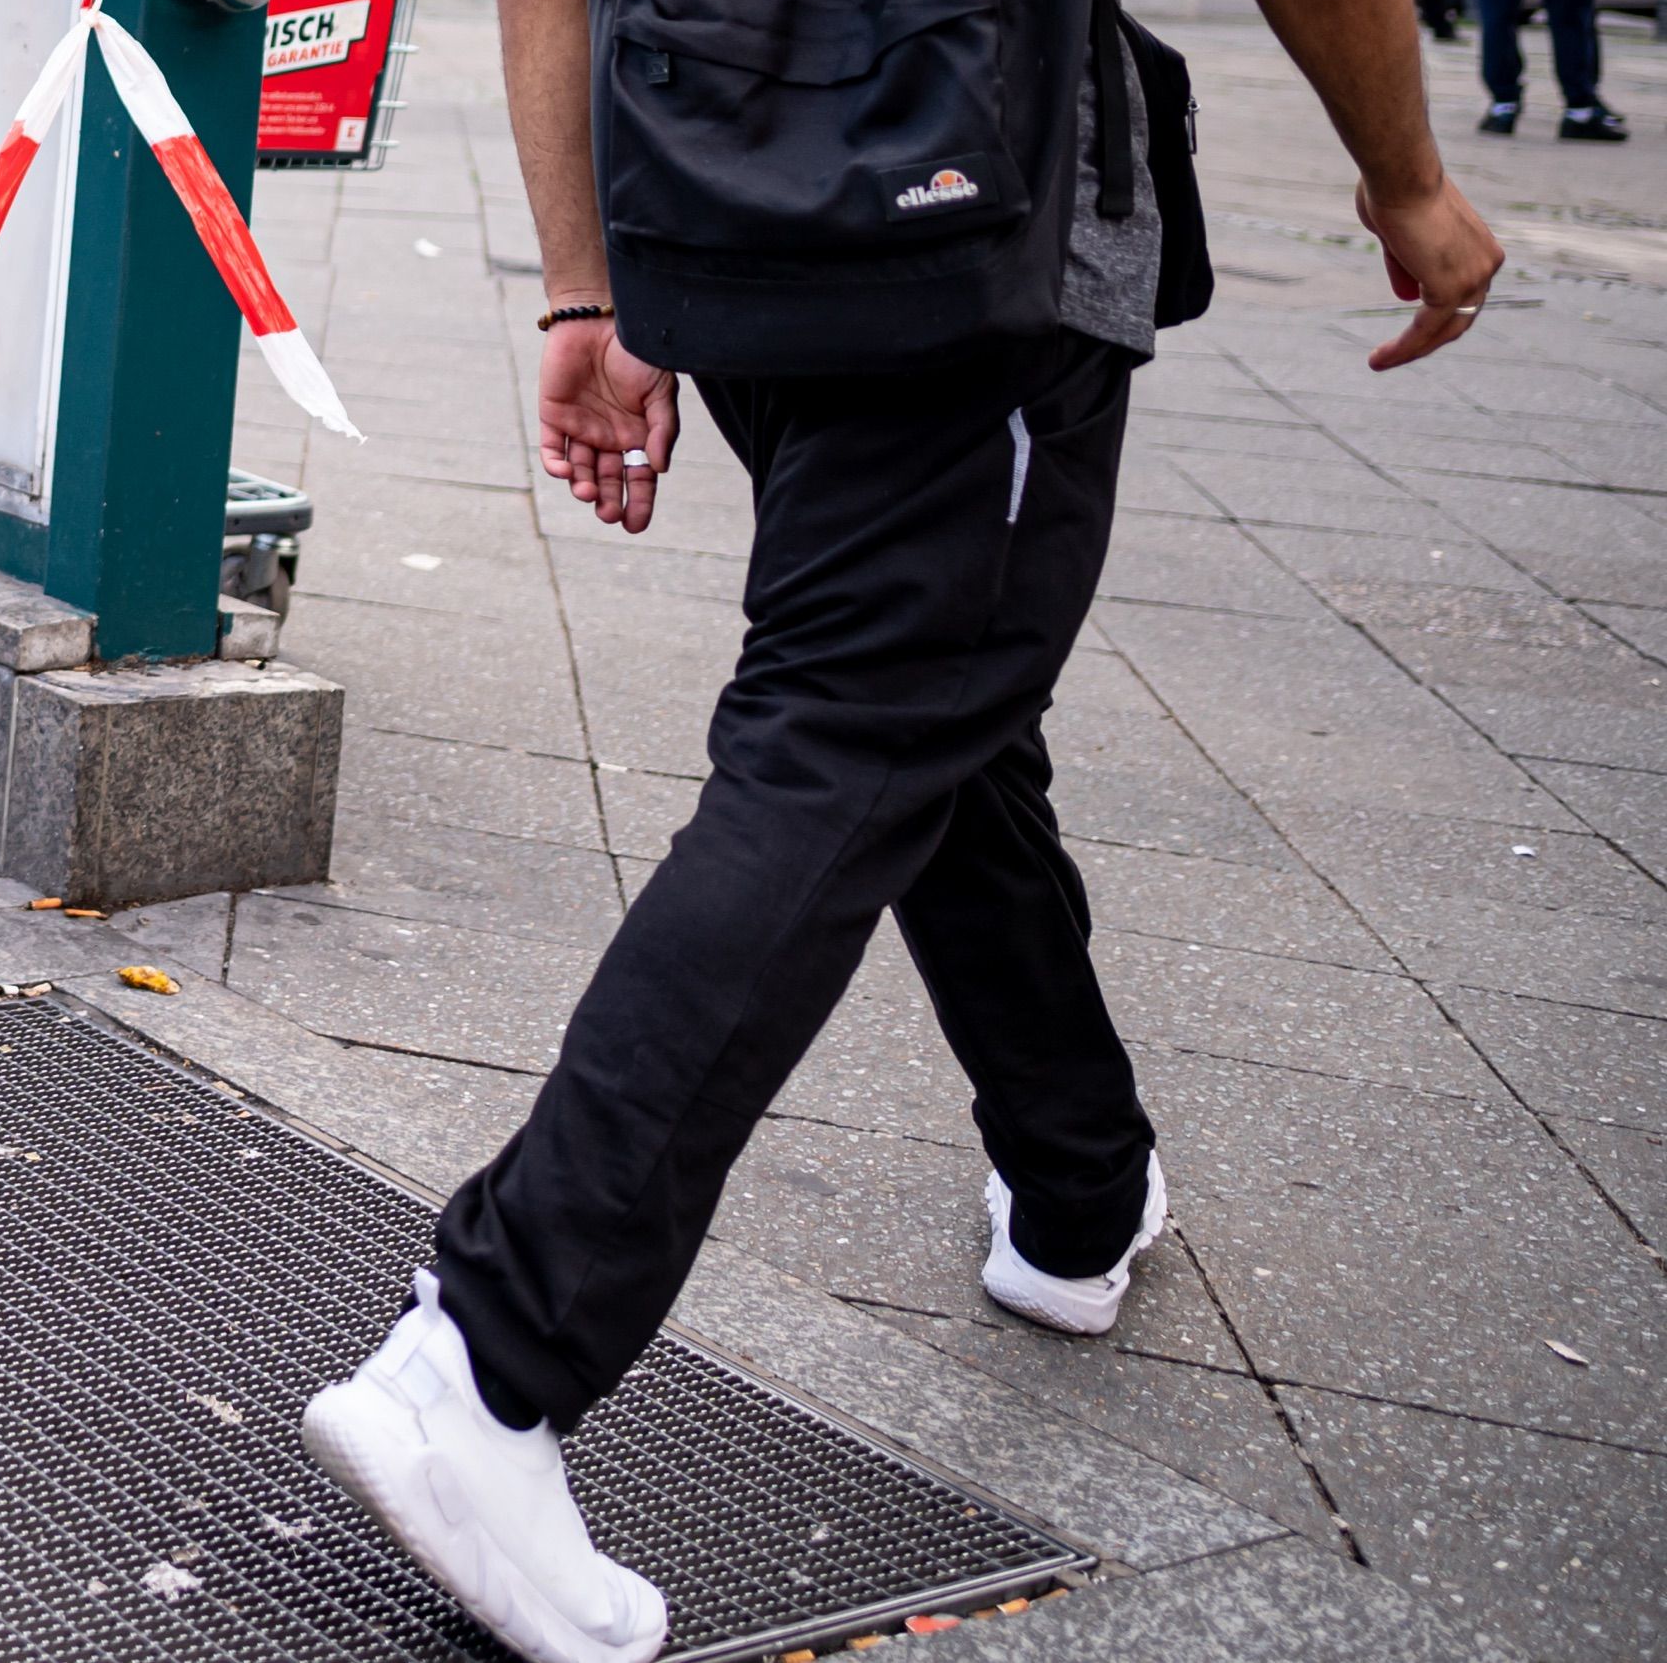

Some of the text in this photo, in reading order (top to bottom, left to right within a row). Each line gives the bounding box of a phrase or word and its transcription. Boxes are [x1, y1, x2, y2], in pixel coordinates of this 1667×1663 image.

[267, 11, 335, 48] ISCH
[267, 39, 344, 67] GARANTIE
[895, 182, 978, 207] ellesse
